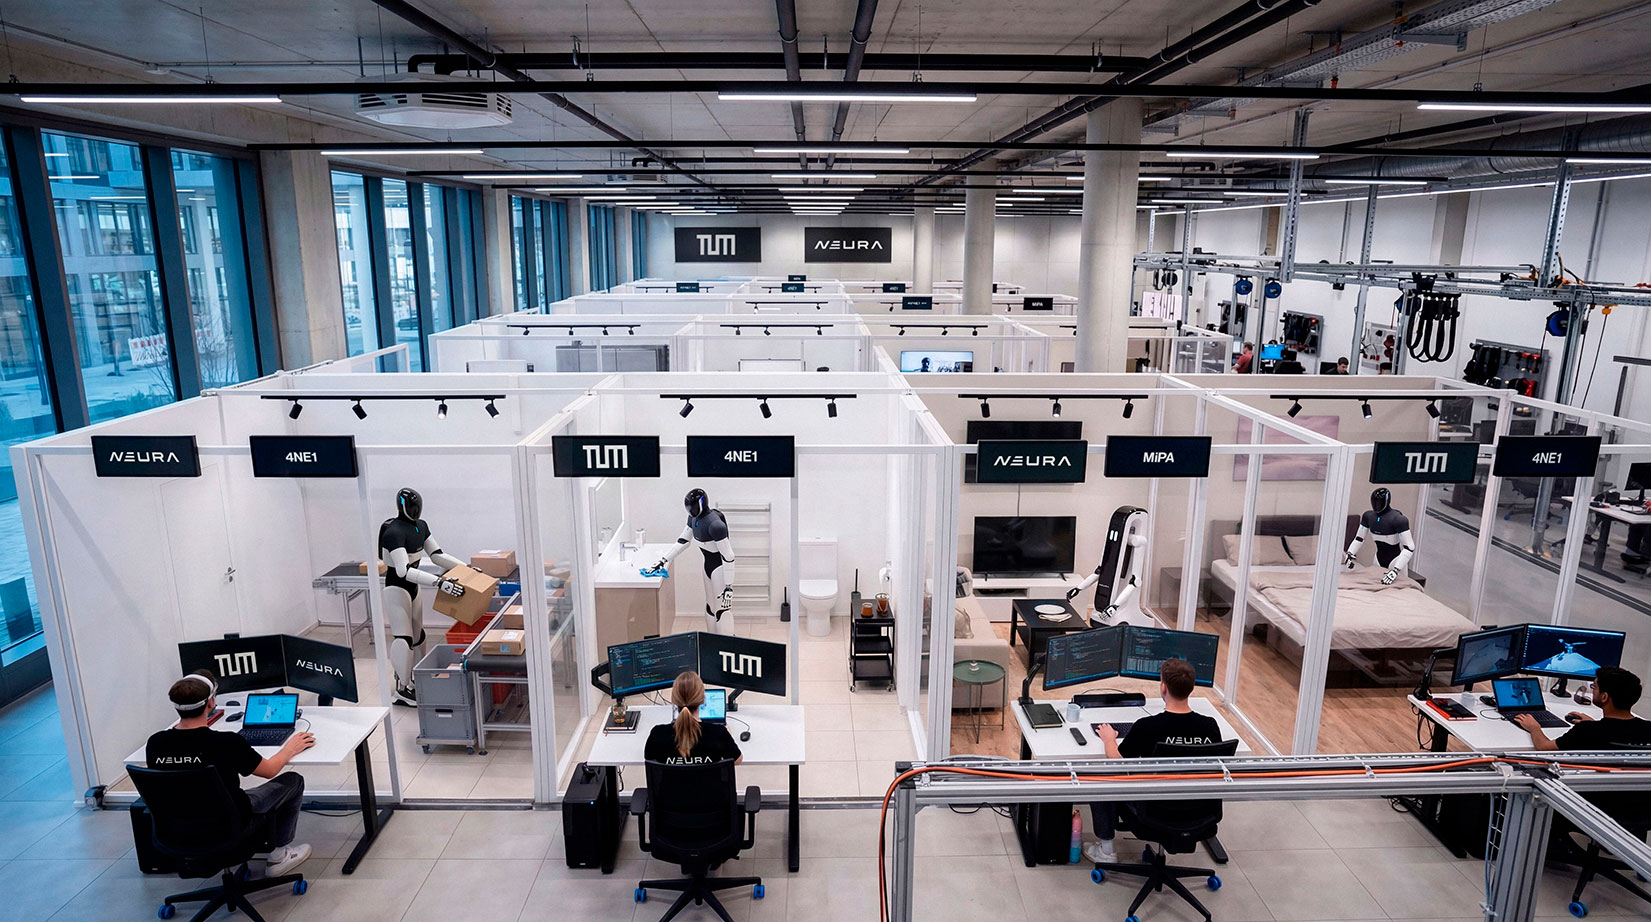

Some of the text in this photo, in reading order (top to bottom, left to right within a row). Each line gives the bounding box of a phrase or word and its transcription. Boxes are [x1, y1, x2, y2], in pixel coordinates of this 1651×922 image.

[697, 234, 736, 256] TUM
[814, 240, 883, 250] NEURA
[109, 451, 180, 463] NEURA
[285, 451, 318, 463] 4NE1
[582, 445, 628, 469] TUM
[724, 451, 758, 462] 4NE1
[993, 455, 1072, 467] NEURA
[1142, 451, 1175, 463] MiPA
[1405, 452, 1448, 473] TUM
[1531, 452, 1562, 464] 4NE1
[213, 651, 258, 678] TUM
[296, 659, 343, 678] NEURA
[718, 650, 762, 678] TUM
[1165, 736, 1212, 745] NEURA
[155, 756, 202, 764] NEURA
[666, 756, 713, 765] NEURA
